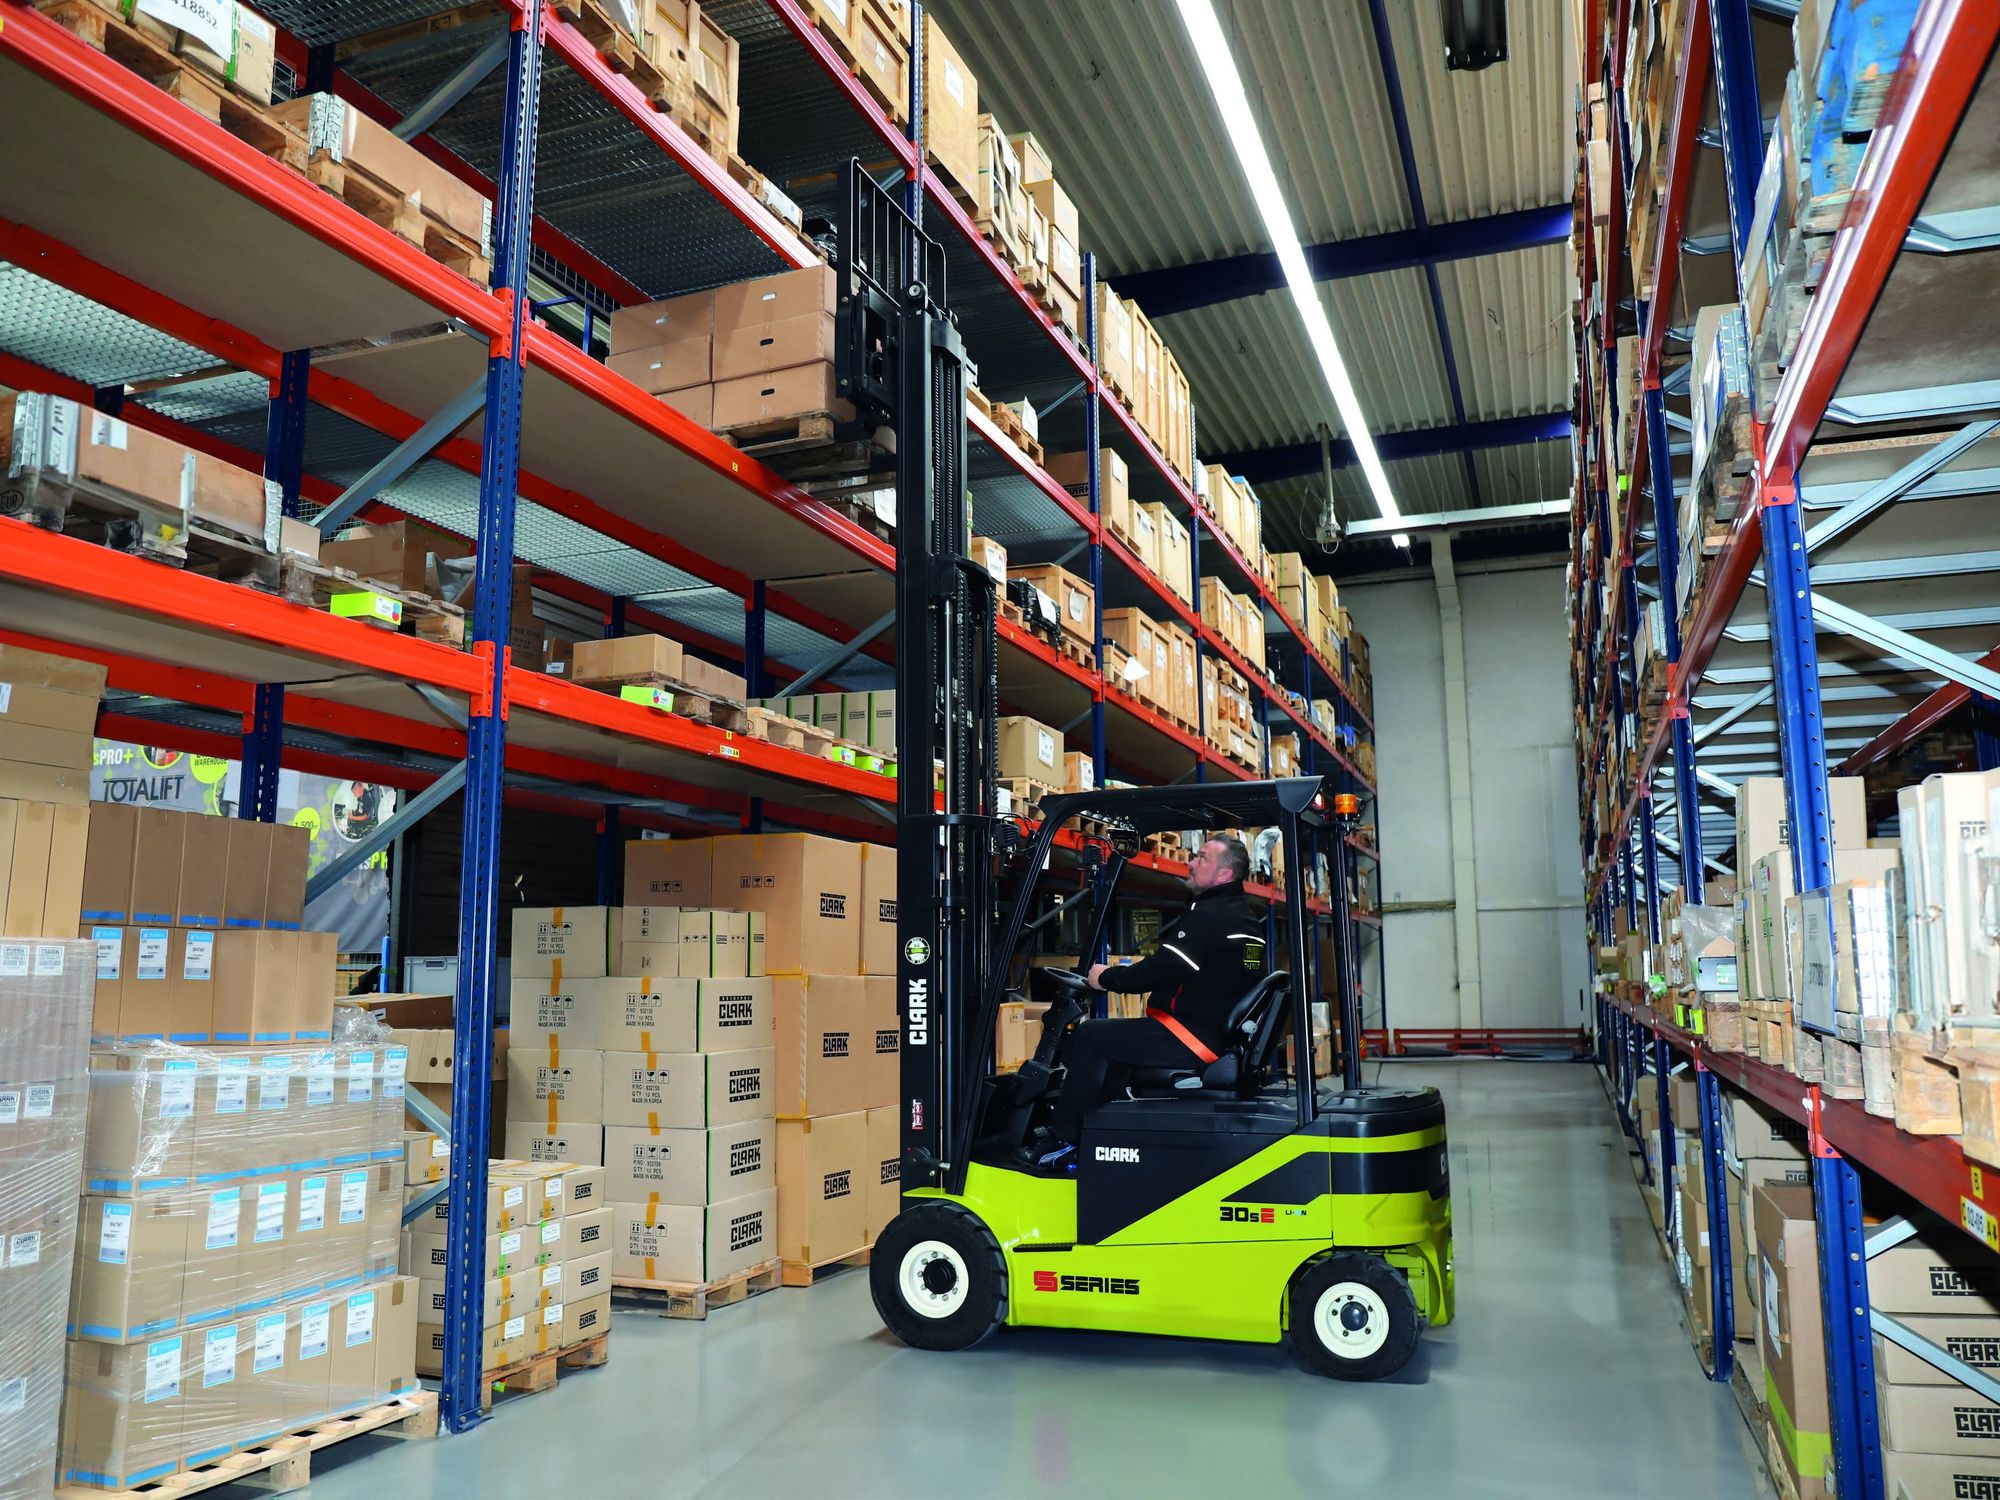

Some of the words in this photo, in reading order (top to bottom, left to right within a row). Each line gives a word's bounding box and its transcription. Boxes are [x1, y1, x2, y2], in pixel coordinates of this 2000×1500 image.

[103, 775, 185, 802] TOTALIFT
[820, 898, 845, 914] CLARK
[719, 1003, 752, 1019] CLARK
[909, 978, 927, 1046] CLARK
[823, 1037, 848, 1052] CLARK
[876, 1035, 899, 1049] CLARK
[729, 1076, 760, 1095] CLARK
[730, 1147, 761, 1169] CLARK
[1095, 1146, 1140, 1163] CLARK
[575, 1185, 592, 1197] CLARK
[824, 1175, 849, 1195] CLARK
[581, 1228, 600, 1241] CLARK
[730, 1219, 762, 1243] CLARK
[432, 1252, 446, 1262] CLA
[581, 1269, 599, 1284] CLARK
[1060, 1275, 1140, 1295] SERIES
[579, 1313, 597, 1327] CLARK
[1947, 1343, 2000, 1361] CLAR
